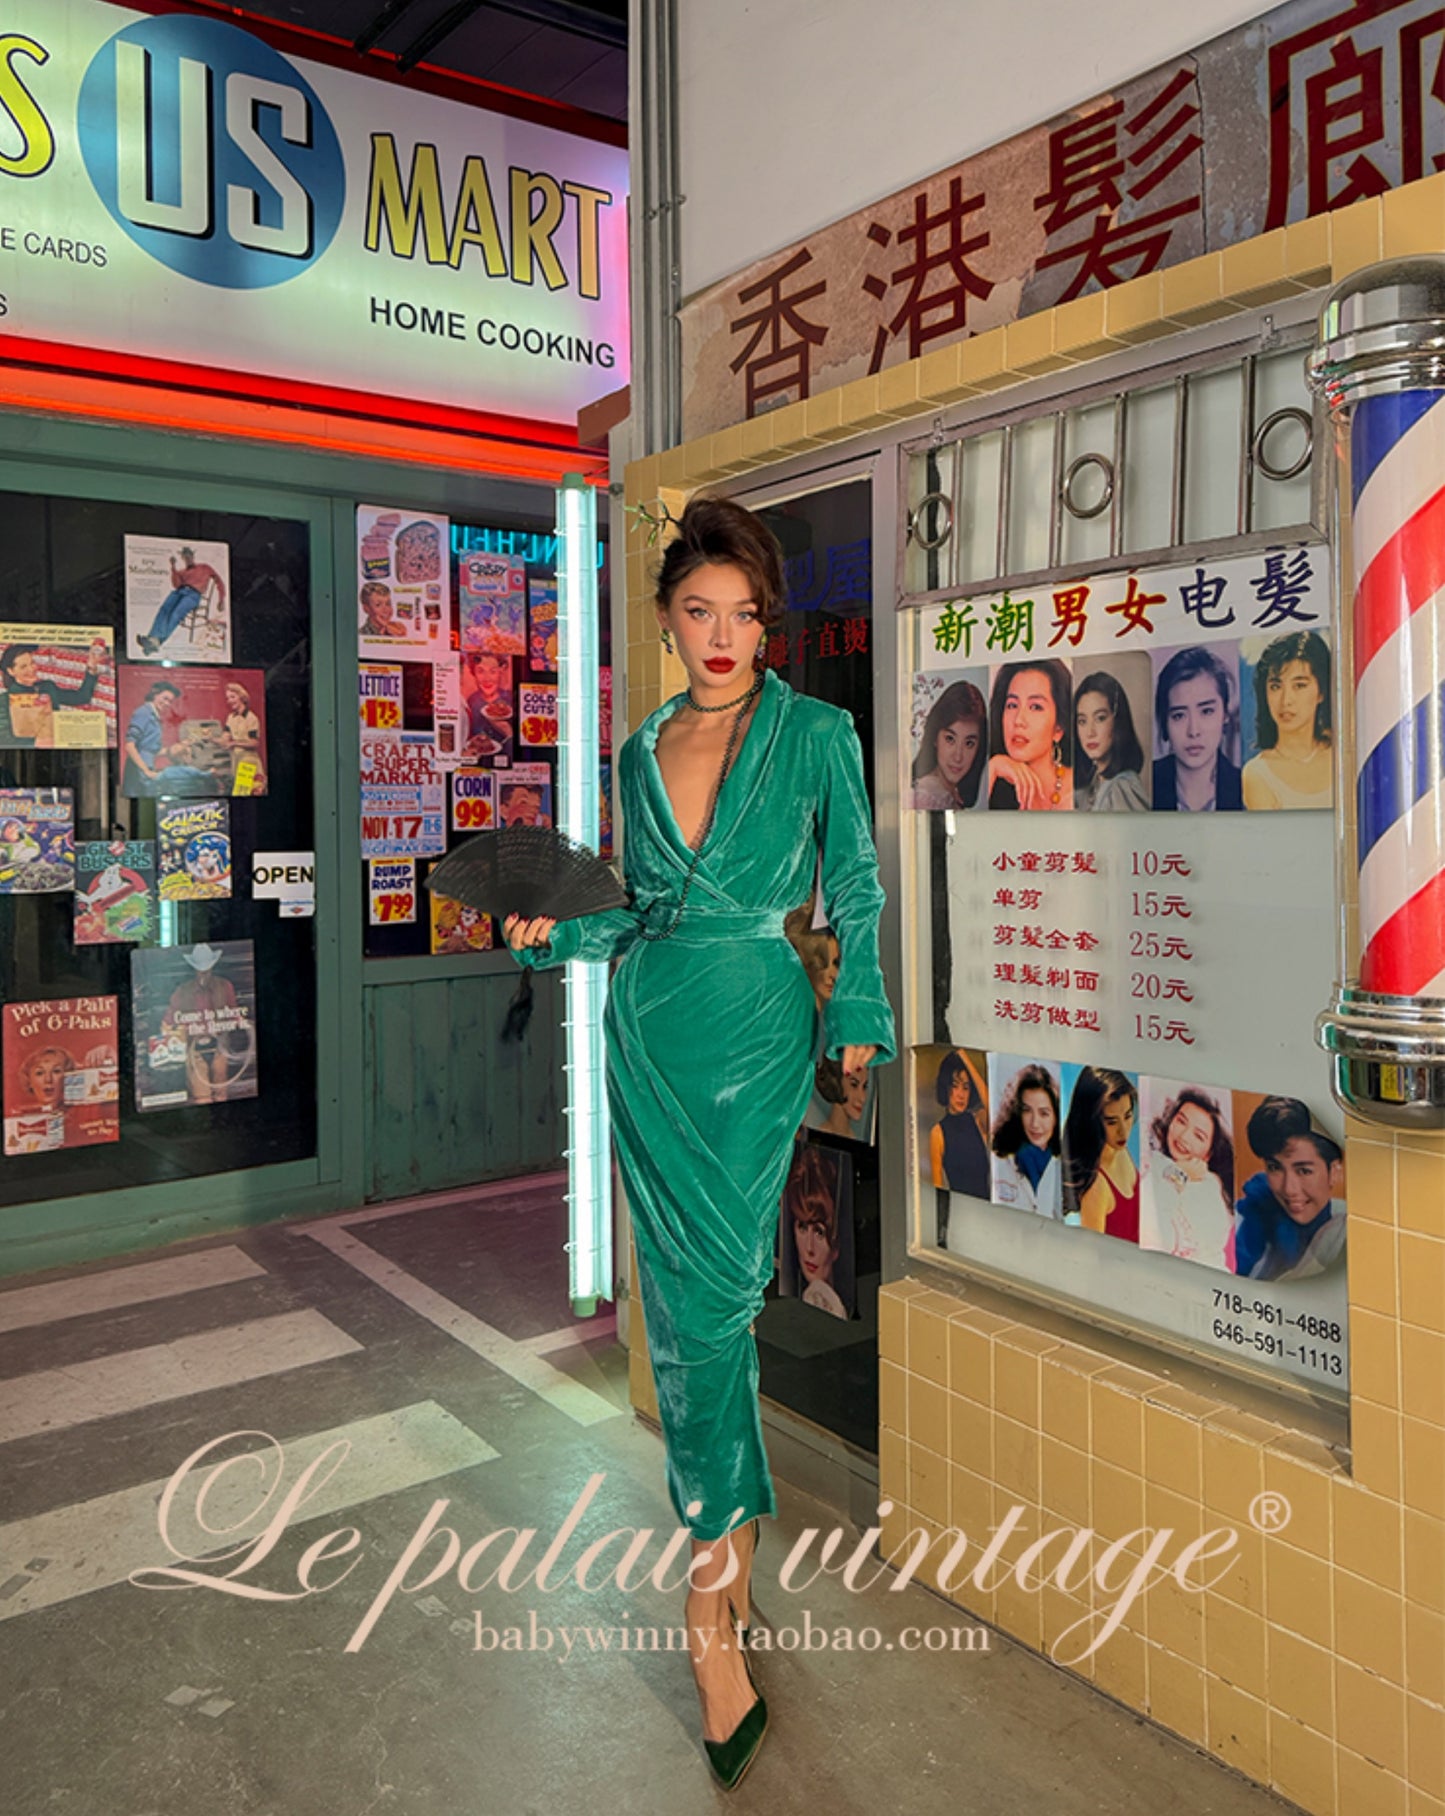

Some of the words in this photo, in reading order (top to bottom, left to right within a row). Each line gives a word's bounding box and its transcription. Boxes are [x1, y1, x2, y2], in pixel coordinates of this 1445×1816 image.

[115, 39, 314, 260] US
[364, 132, 612, 300] MART
[24, 231, 107, 268] CARDS
[370, 296, 466, 341] HOME
[477, 318, 616, 369] COOKING
[359, 674, 400, 697] LETTUCE
[524, 693, 556, 705] COLD
[524, 704, 555, 716] CUTS
[373, 757, 430, 772] SUPER
[456, 777, 492, 797] CORN
[252, 865, 314, 885] OPEN
[375, 866, 411, 877] RUMP
[1131, 850, 1192, 877] 10元
[371, 878, 414, 890] ROAST
[992, 887, 1043, 910] 单剪
[1132, 891, 1193, 919] 15元
[1129, 930, 1193, 961] 25元
[1130, 972, 1195, 1003] 20元
[11, 1000, 52, 1022] Pick
[58, 1001, 70, 1012] a
[75, 997, 115, 1013] Pair
[173, 1010, 202, 1024] Come
[204, 1008, 215, 1021] to
[216, 1005, 249, 1019] where
[20, 1017, 41, 1038] of
[47, 1013, 112, 1031] 6-Paks
[188, 1022, 206, 1036] the
[994, 999, 1101, 1032] 洗剪做型
[1135, 1014, 1196, 1046] 15元
[1212, 1288, 1342, 1344] 718-961-4888
[1213, 1321, 1343, 1376] 646-591-1113
